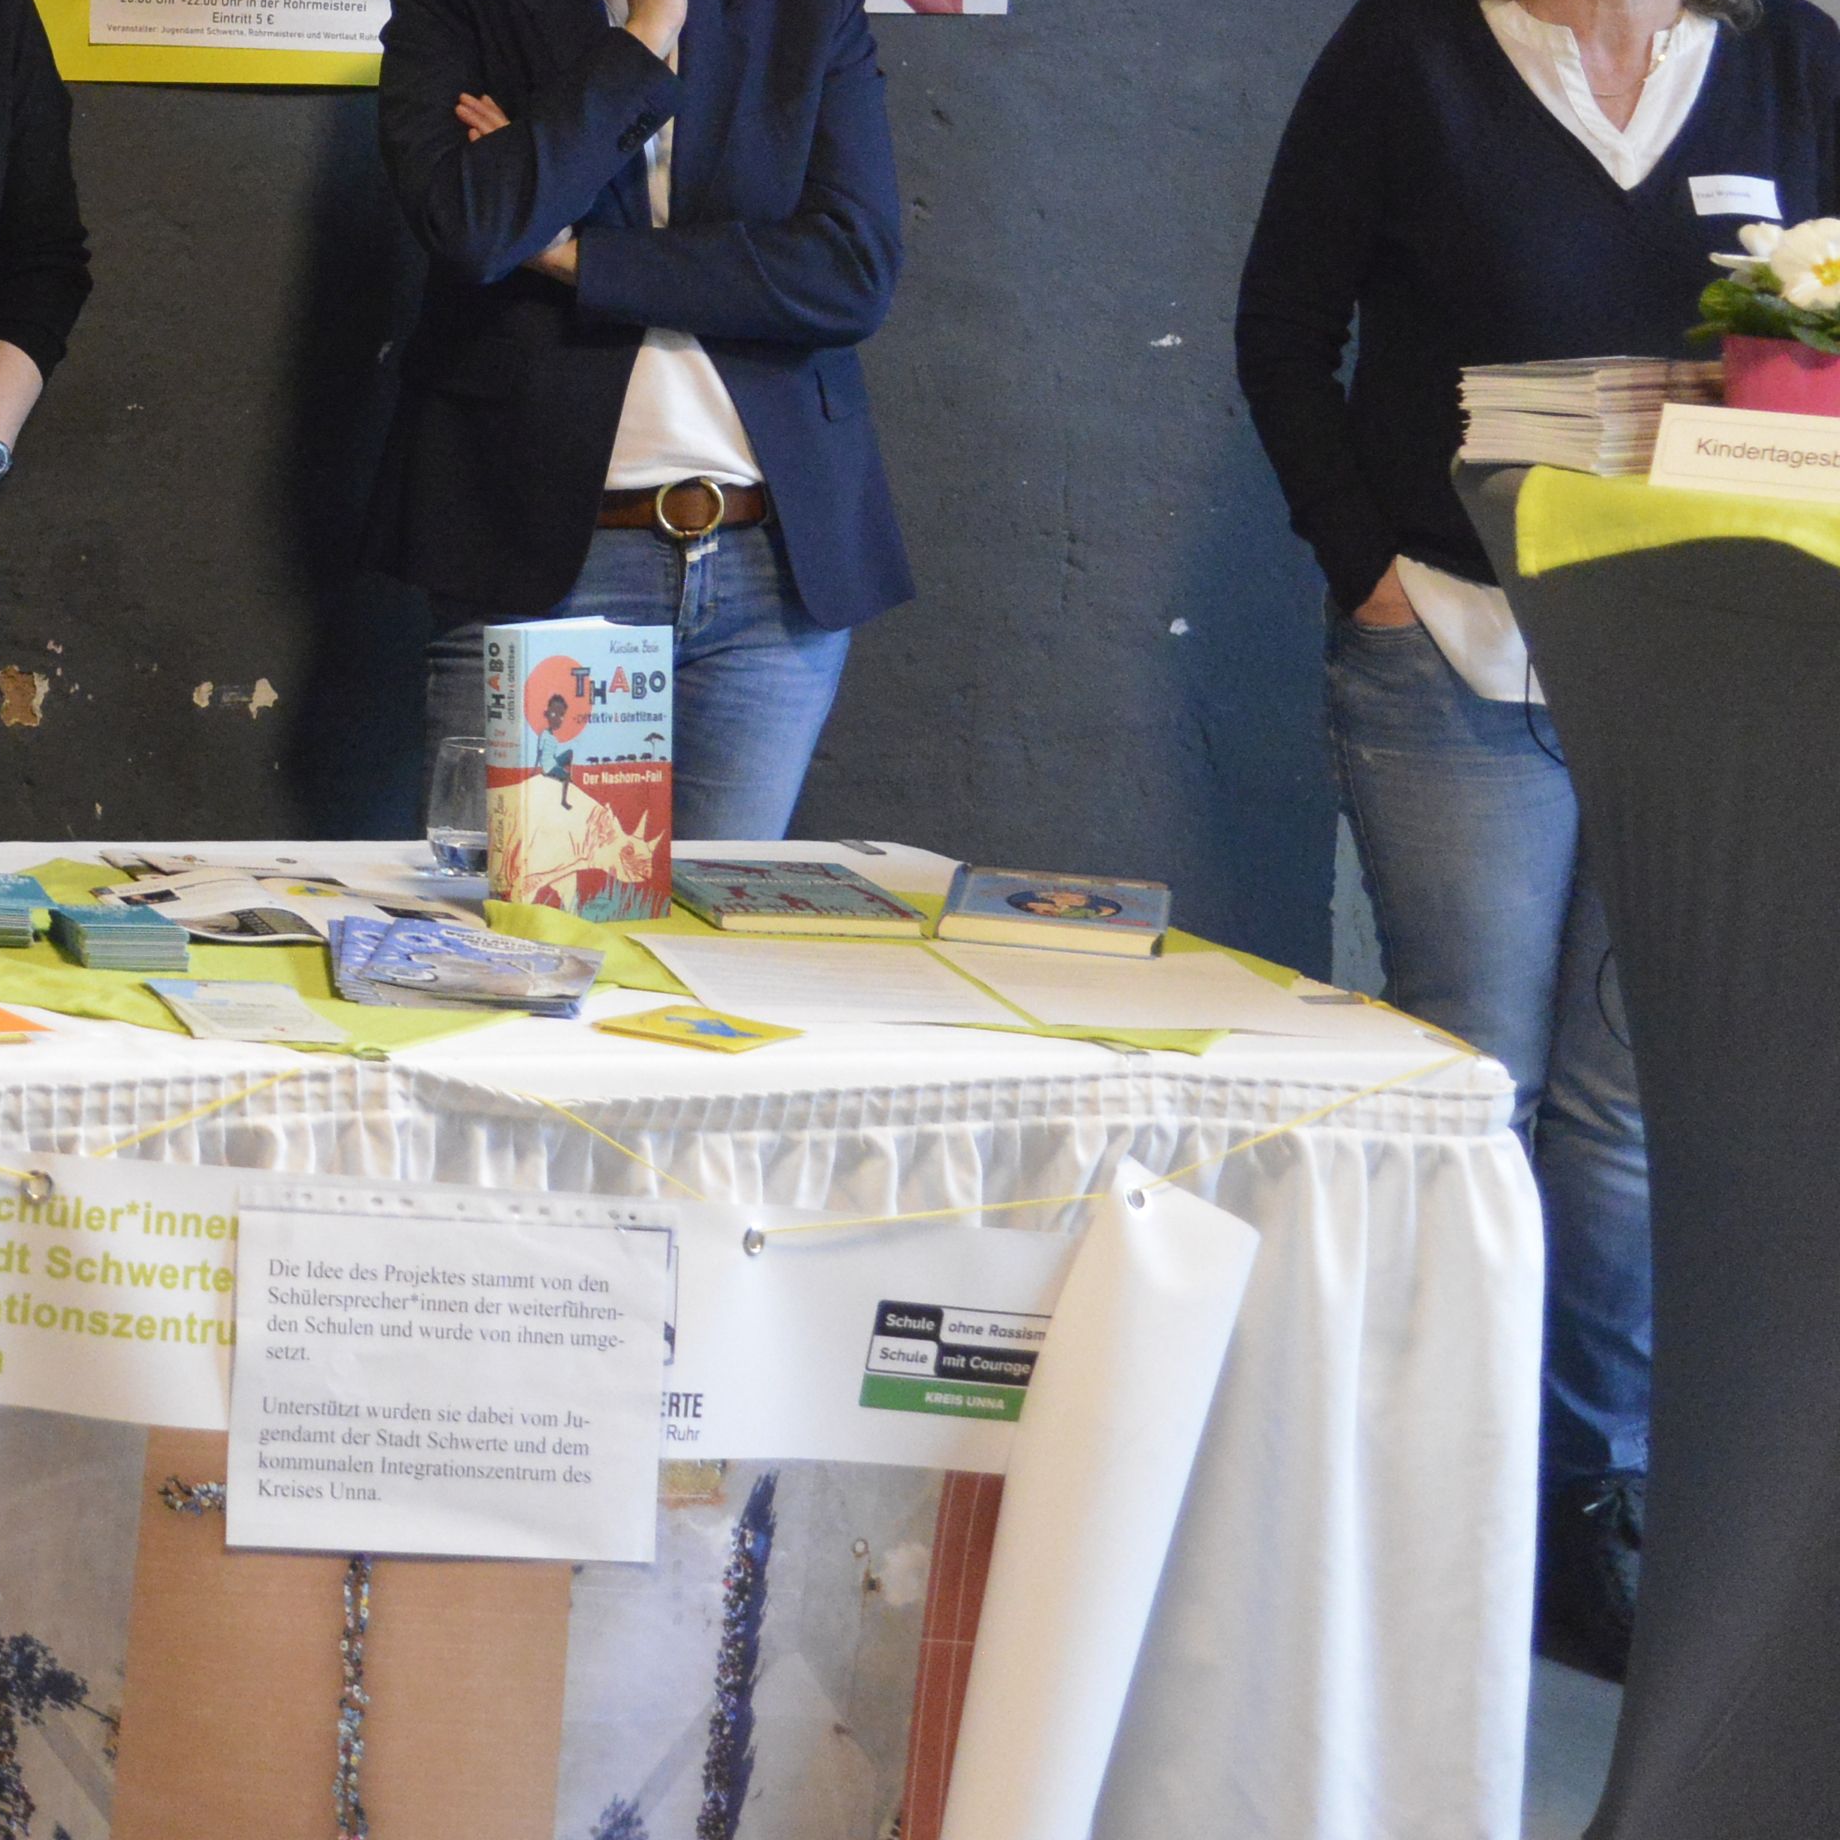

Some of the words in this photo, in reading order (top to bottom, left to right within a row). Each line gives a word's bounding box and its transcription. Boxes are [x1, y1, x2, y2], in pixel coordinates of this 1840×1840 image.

[212, 12, 252, 24] Eintritt
[256, 13, 262, 24] 5
[267, 14, 274, 25] €
[161, 25, 204, 36] Jugendamt
[248, 29, 304, 39] Rohrmeisterei
[306, 31, 320, 39] und
[323, 32, 356, 40] Wortlaut
[488, 642, 505, 722] THABO
[571, 666, 666, 705] THABO
[583, 772, 599, 784] Der
[45, 1245, 236, 1292] Schwerte
[269, 1259, 300, 1277] Die
[307, 1261, 342, 1280] Idee
[349, 1263, 377, 1281] des
[384, 1264, 465, 1287] Projektes
[471, 1270, 534, 1289] stammt
[540, 1276, 572, 1291] von
[578, 1275, 609, 1292] den
[474, 1297, 500, 1314] der
[507, 1300, 624, 1321] weiterführen-
[267, 1315, 298, 1332] den
[305, 1316, 373, 1335] Schulen
[380, 1320, 412, 1337] und
[419, 1322, 471, 1340] wurde
[479, 1327, 511, 1342] von
[518, 1325, 564, 1344] ihnen
[571, 1331, 624, 1351] umge-
[885, 1314, 935, 1330] Schule
[949, 1322, 984, 1335] ohne
[989, 1324, 1046, 1340] Rassism
[266, 1345, 310, 1361] setzt.
[880, 1347, 928, 1363] Schule
[942, 1354, 965, 1368] mit
[970, 1357, 1030, 1375] Courage
[262, 1396, 359, 1419] Unterstützt
[366, 1402, 431, 1421] wurden
[438, 1404, 461, 1422] sie
[467, 1405, 513, 1425] dabei
[520, 1411, 558, 1426] vom
[564, 1411, 590, 1429] Ju-
[661, 1392, 702, 1419] RTE
[925, 1392, 963, 1405] KREIS
[967, 1395, 1005, 1410] UNNA
[258, 1427, 336, 1446] gendamt
[341, 1429, 370, 1446] der
[376, 1430, 421, 1449] Stadt
[426, 1432, 509, 1452] Schwerte
[514, 1436, 546, 1454] und
[552, 1437, 589, 1456] dem
[667, 1425, 699, 1441] Ruhr
[258, 1452, 373, 1474] kommunalen
[380, 1456, 557, 1482] Integrationszentrum
[562, 1464, 591, 1483] des
[258, 1479, 323, 1499] Kreises
[329, 1480, 381, 1501] Unna.
